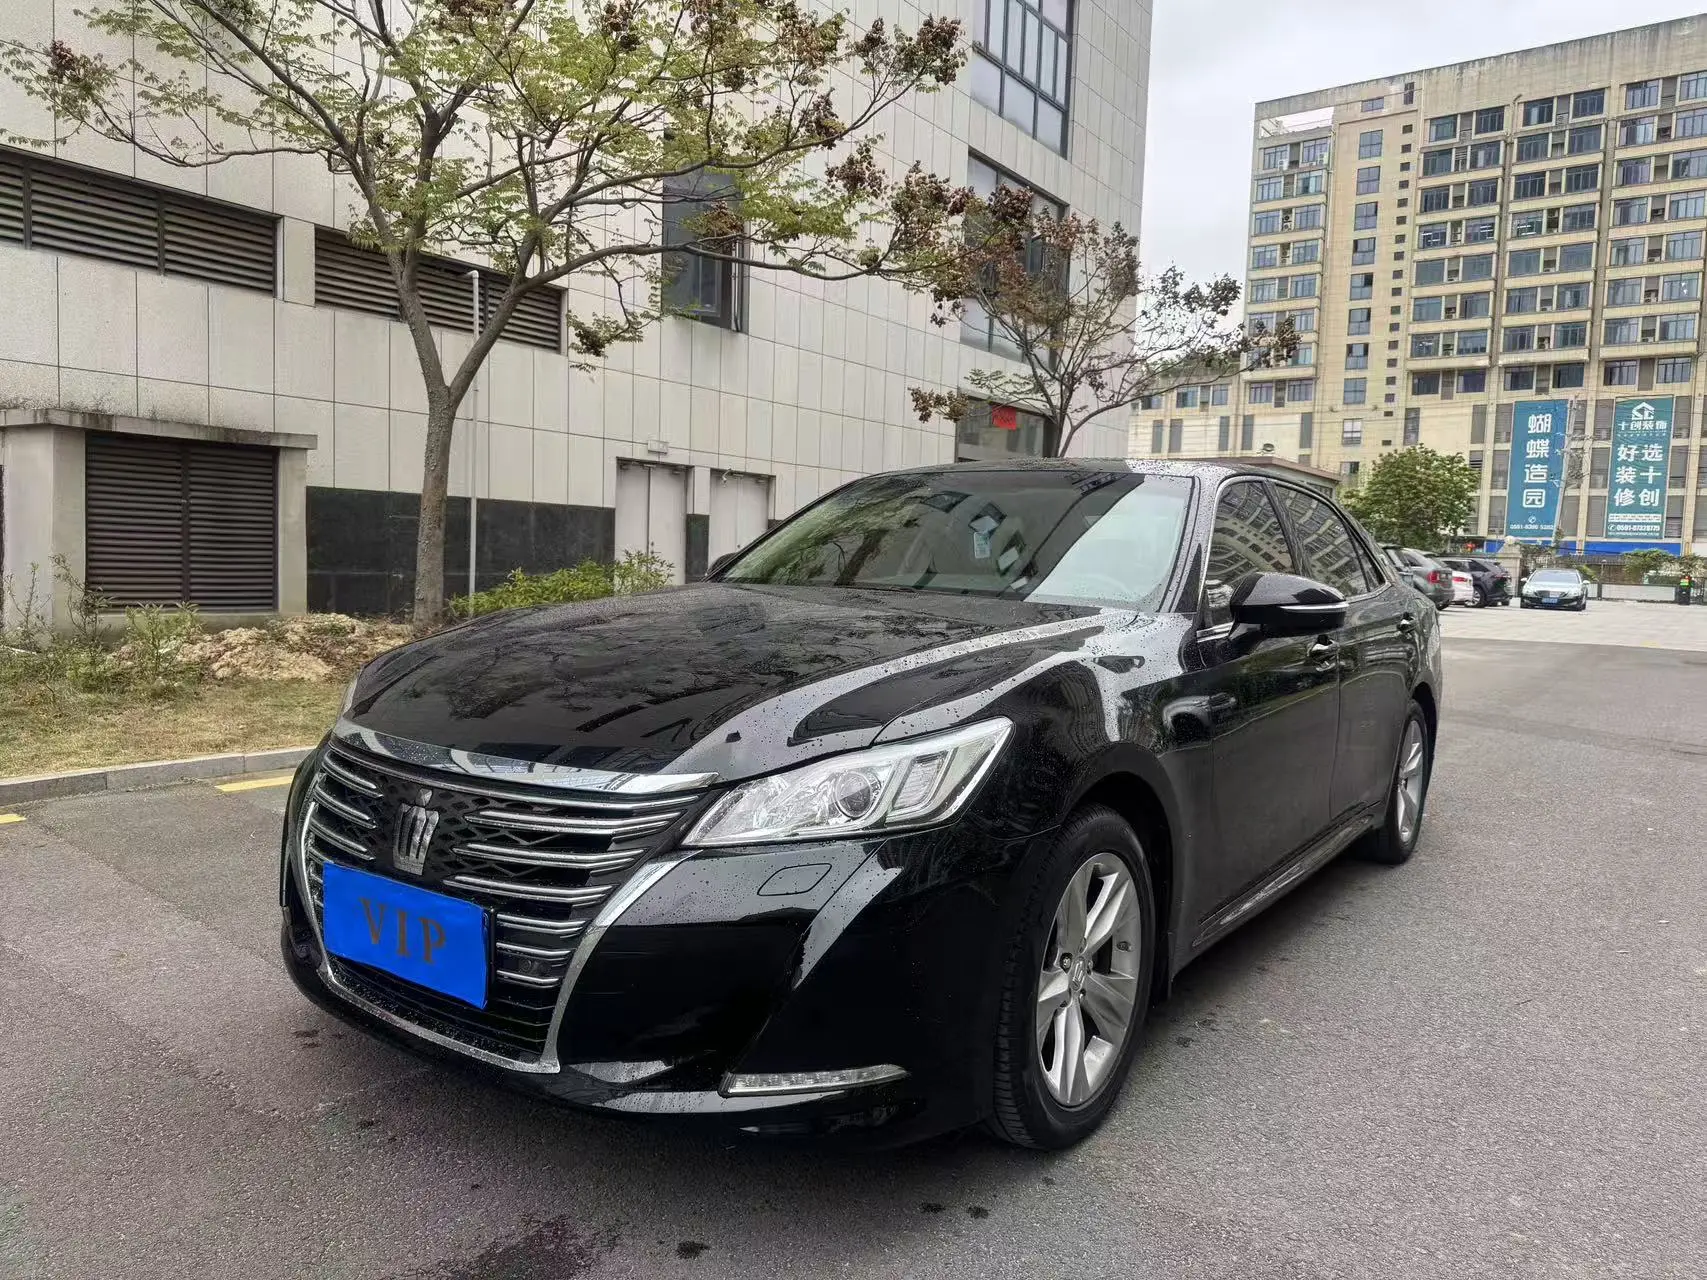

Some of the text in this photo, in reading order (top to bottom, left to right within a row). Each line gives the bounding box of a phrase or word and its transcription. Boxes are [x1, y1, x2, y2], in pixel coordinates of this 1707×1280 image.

[1617, 420, 1667, 431] 十创装饰
[1522, 413, 1552, 508] 蝴蝶造园
[1613, 444, 1639, 507] 好装修
[1639, 443, 1663, 507] 选十创
[359, 897, 447, 965] VIP
